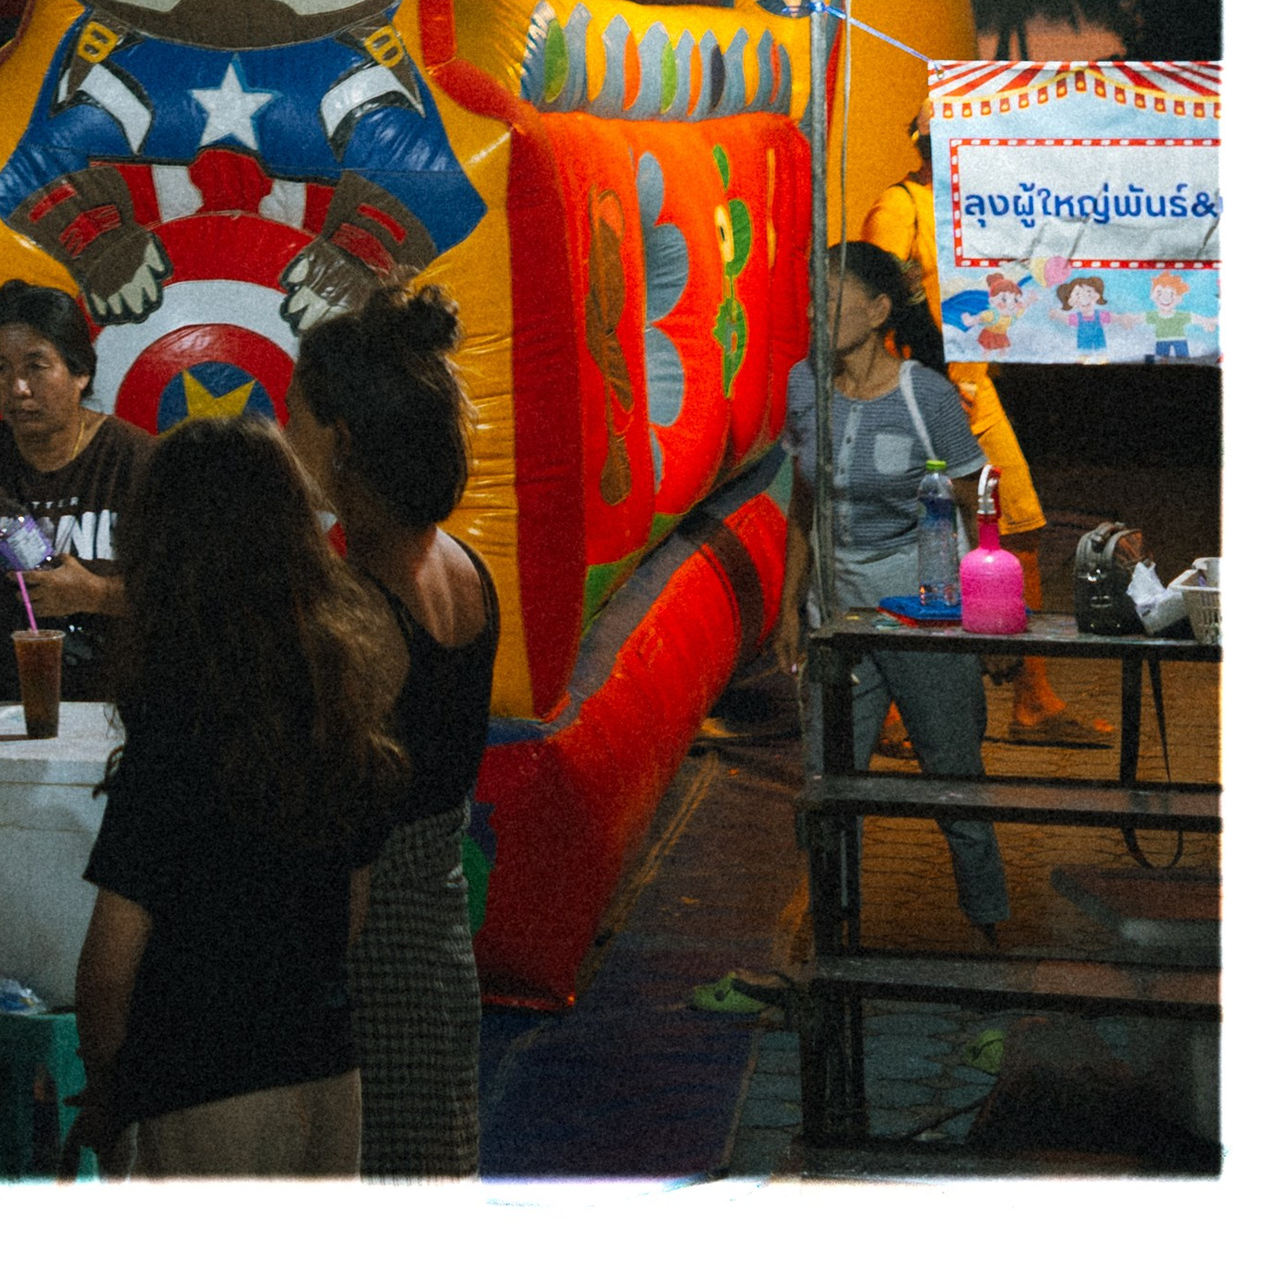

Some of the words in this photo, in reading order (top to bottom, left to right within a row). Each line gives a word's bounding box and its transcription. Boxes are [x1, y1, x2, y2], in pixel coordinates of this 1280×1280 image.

[963, 182, 1223, 228] ลุงผู้ใหญ่พันธ์&
